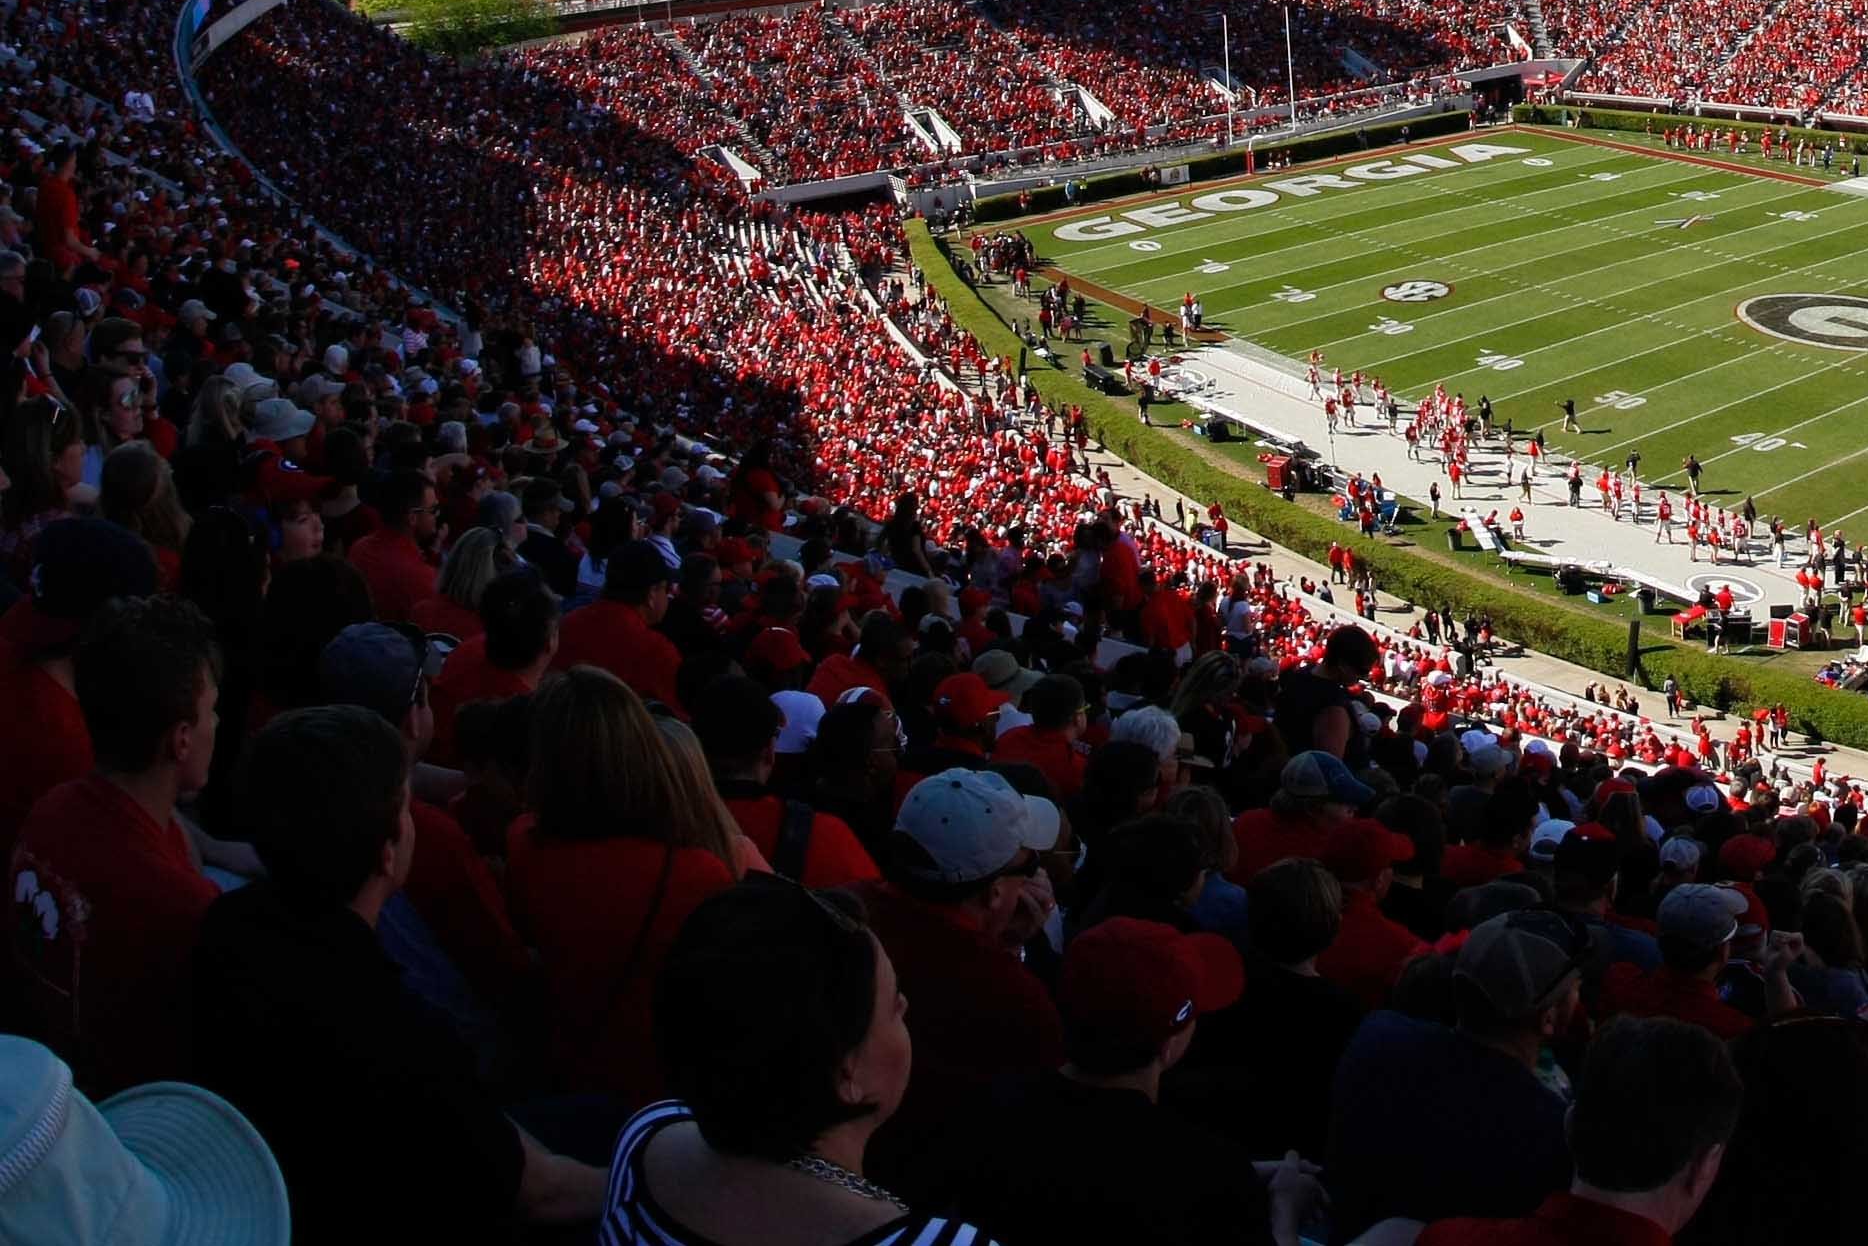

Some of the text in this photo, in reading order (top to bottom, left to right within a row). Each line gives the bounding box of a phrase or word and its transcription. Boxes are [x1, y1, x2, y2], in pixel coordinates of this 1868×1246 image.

[1052, 142, 1533, 242] GEORGIA
[1474, 353, 1525, 371] 40
[1594, 389, 1648, 410] 50
[1730, 431, 1787, 452] 40
